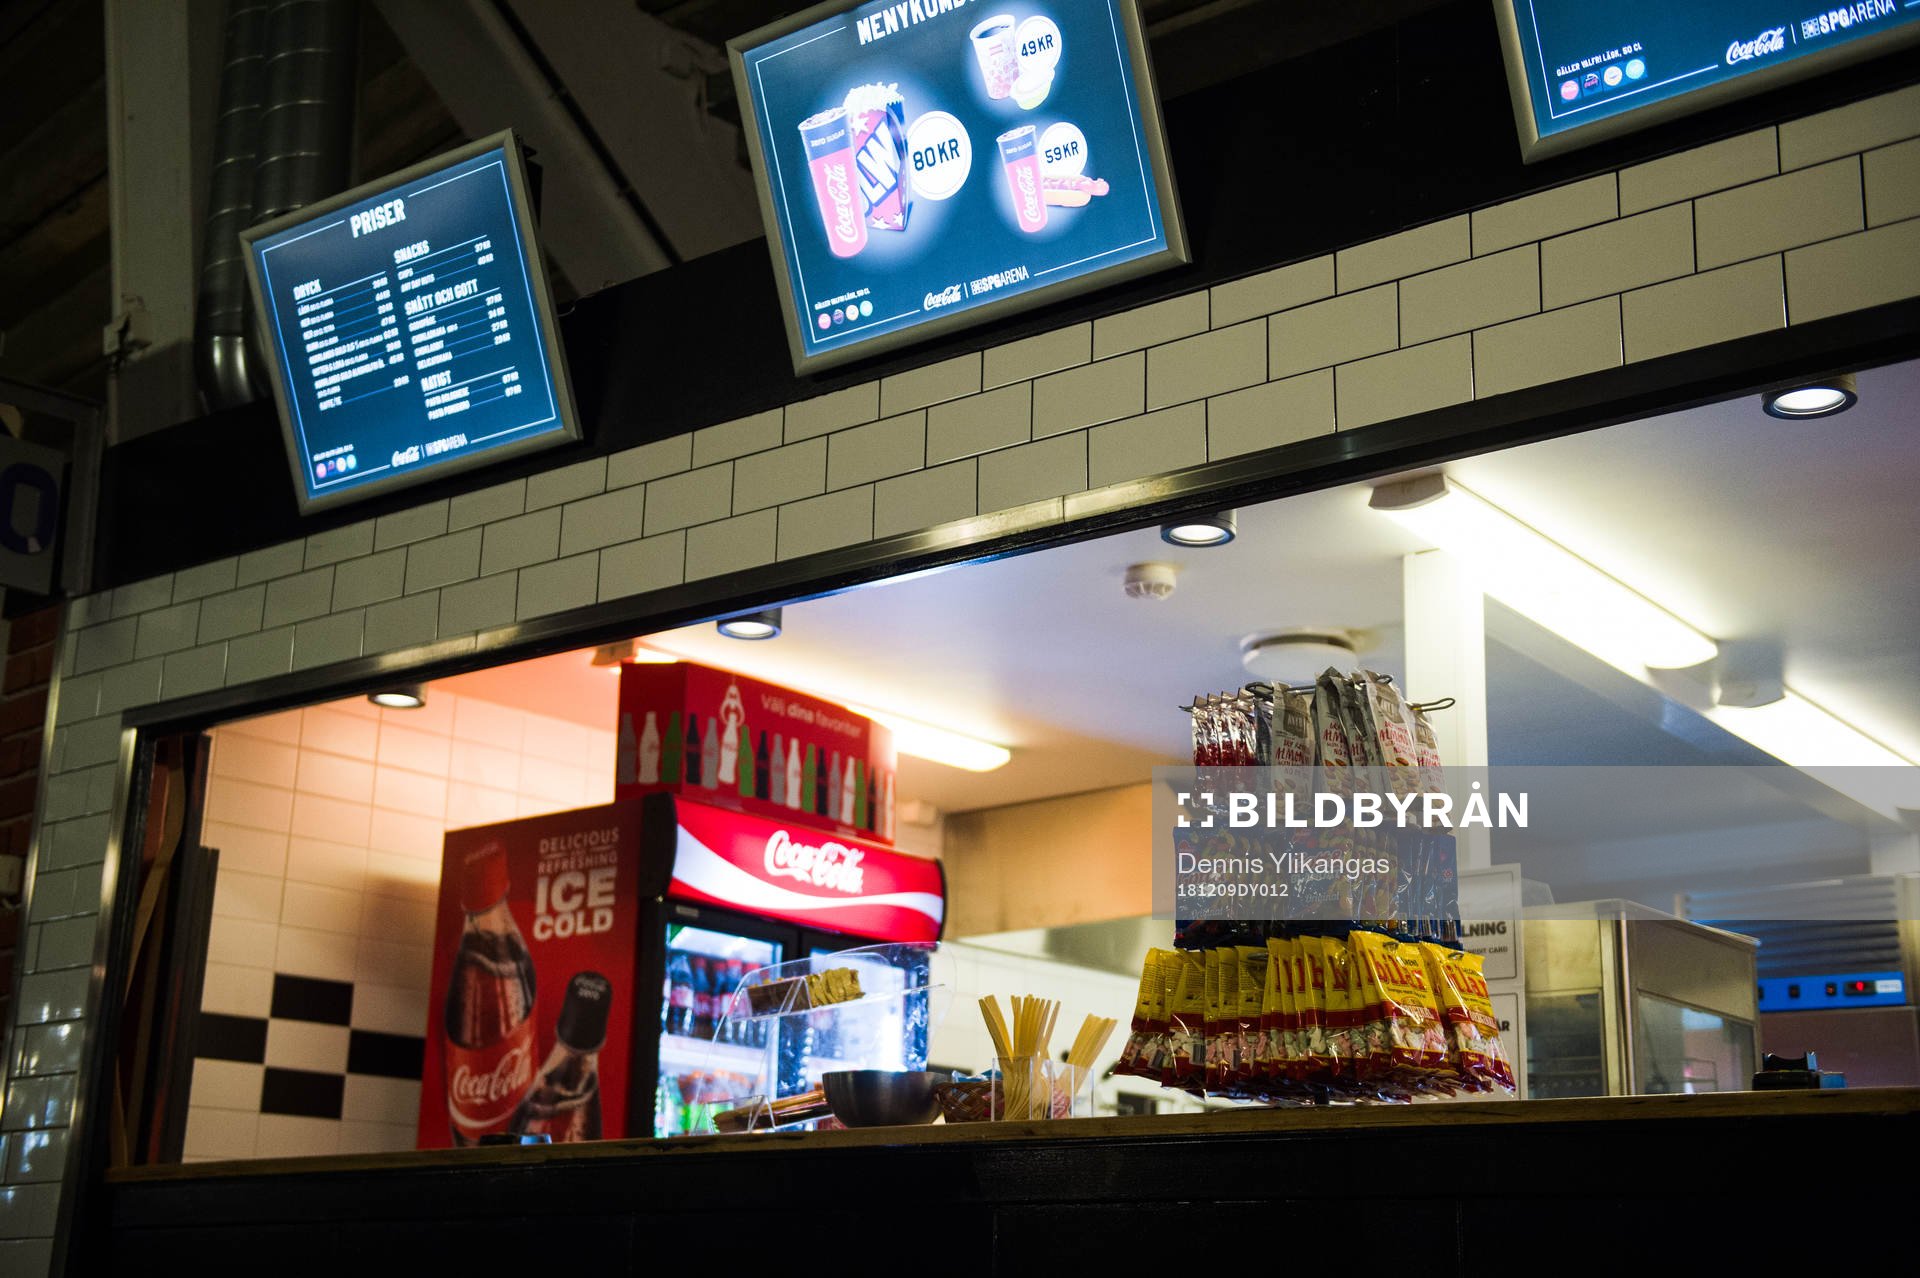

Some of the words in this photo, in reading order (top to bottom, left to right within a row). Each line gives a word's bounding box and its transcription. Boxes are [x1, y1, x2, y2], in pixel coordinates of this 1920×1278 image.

[856, 0, 978, 45] MENYKOM
[1020, 40, 1037, 57] 49
[1037, 34, 1054, 52] KR
[1556, 63, 1580, 77] GÄLLER
[1581, 55, 1602, 69] VALFRI
[1622, 45, 1633, 55] 50
[1633, 42, 1643, 52] CL
[912, 147, 937, 171] 80
[937, 138, 961, 163] KR
[1045, 146, 1063, 164] 59
[1063, 140, 1080, 159] KR
[350, 198, 405, 238] PRISER
[393, 239, 430, 265] SNACKS
[434, 287, 454, 306] OCH
[454, 279, 478, 299] GOTT
[540, 827, 619, 853] DELICIOUS
[538, 850, 618, 873] REFRESHING
[764, 829, 865, 894] Coca-Cola
[536, 866, 617, 914] ICE
[533, 907, 614, 941] COLD
